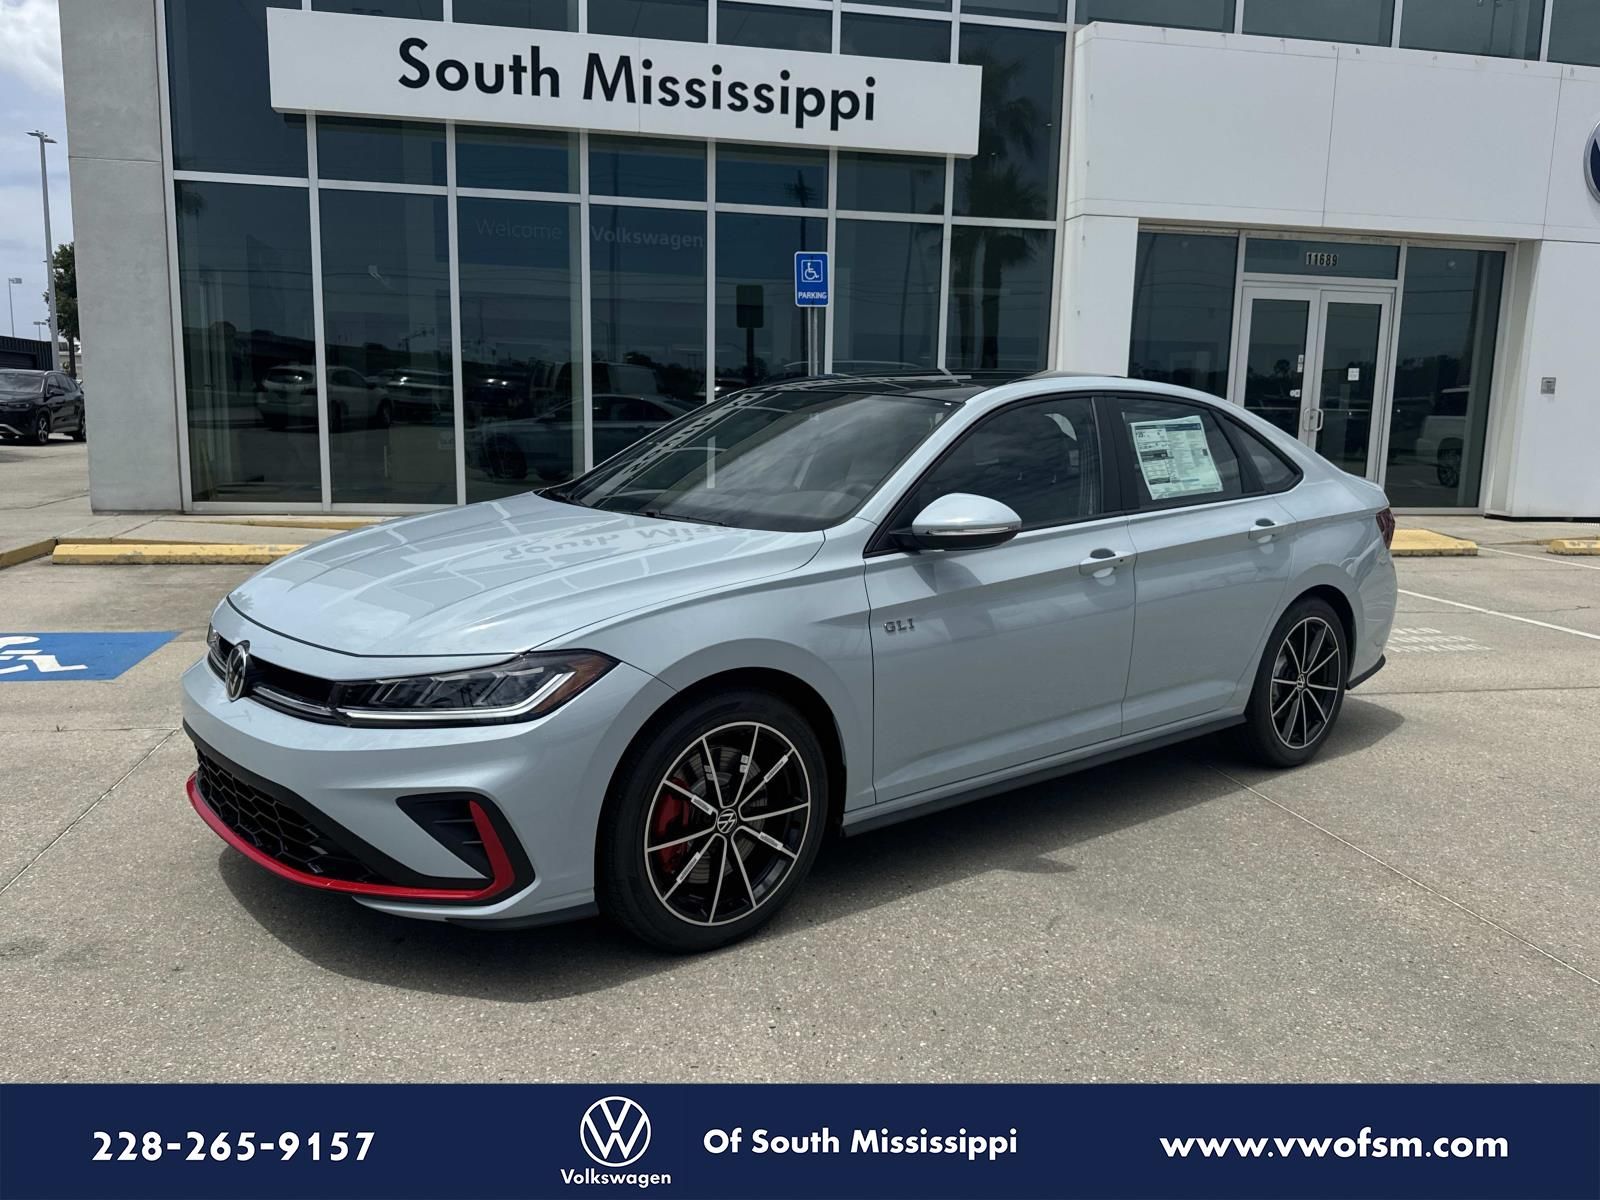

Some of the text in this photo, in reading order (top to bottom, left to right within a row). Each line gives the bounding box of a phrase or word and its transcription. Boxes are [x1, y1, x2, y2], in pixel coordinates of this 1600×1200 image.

[398, 37, 876, 131] South Mississippi
[475, 217, 705, 250] Welcome Volkswagen
[1307, 253, 1338, 266] 11689
[798, 291, 828, 300] PARKING
[884, 618, 915, 632] GLI
